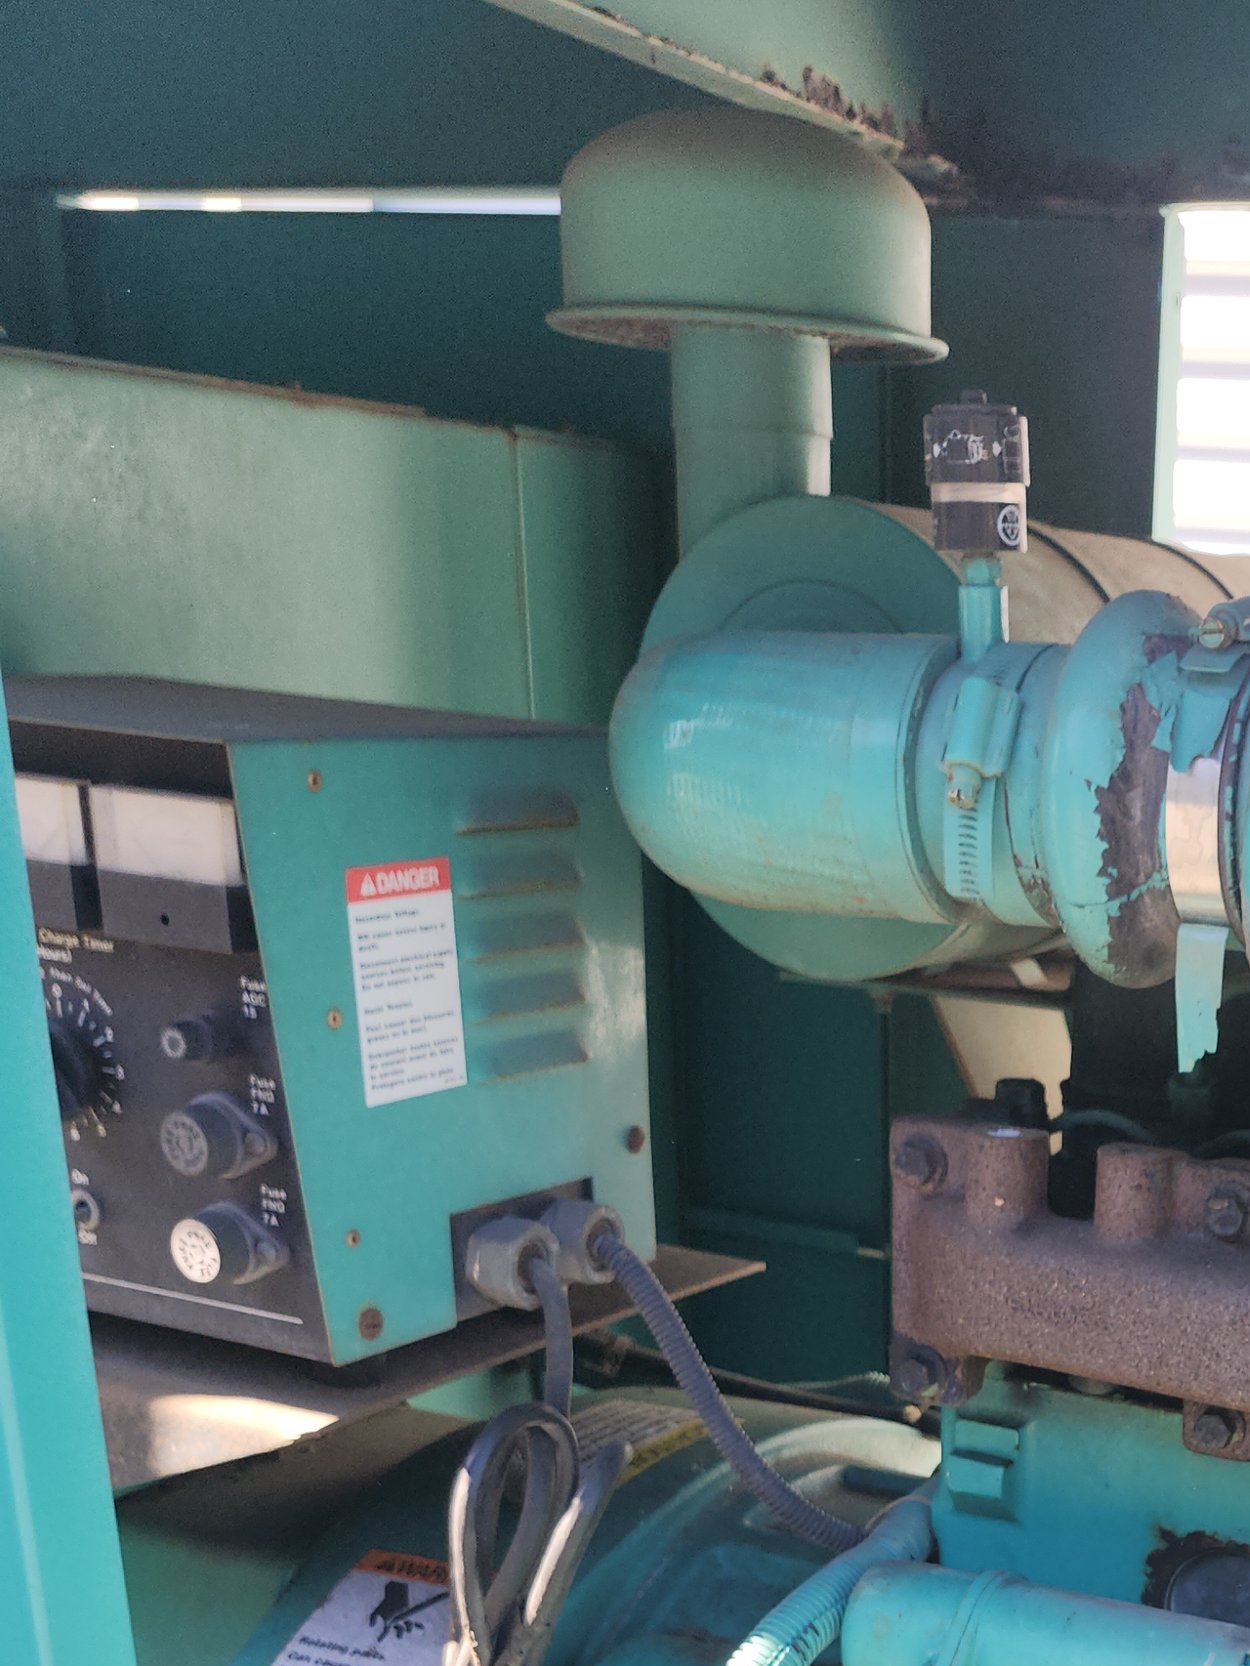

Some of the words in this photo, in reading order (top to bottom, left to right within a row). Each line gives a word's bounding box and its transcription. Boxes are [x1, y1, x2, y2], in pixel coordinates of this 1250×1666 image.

[375, 865, 441, 896] DANGER
[82, 933, 115, 954] Timer
[240, 975, 266, 993] Fuse
[250, 1073, 277, 1091] Fuse
[71, 1168, 90, 1186] On
[260, 1183, 288, 1202] Fuse
[299, 1636, 349, 1656] Rotating
[287, 1651, 312, 1664] Can
